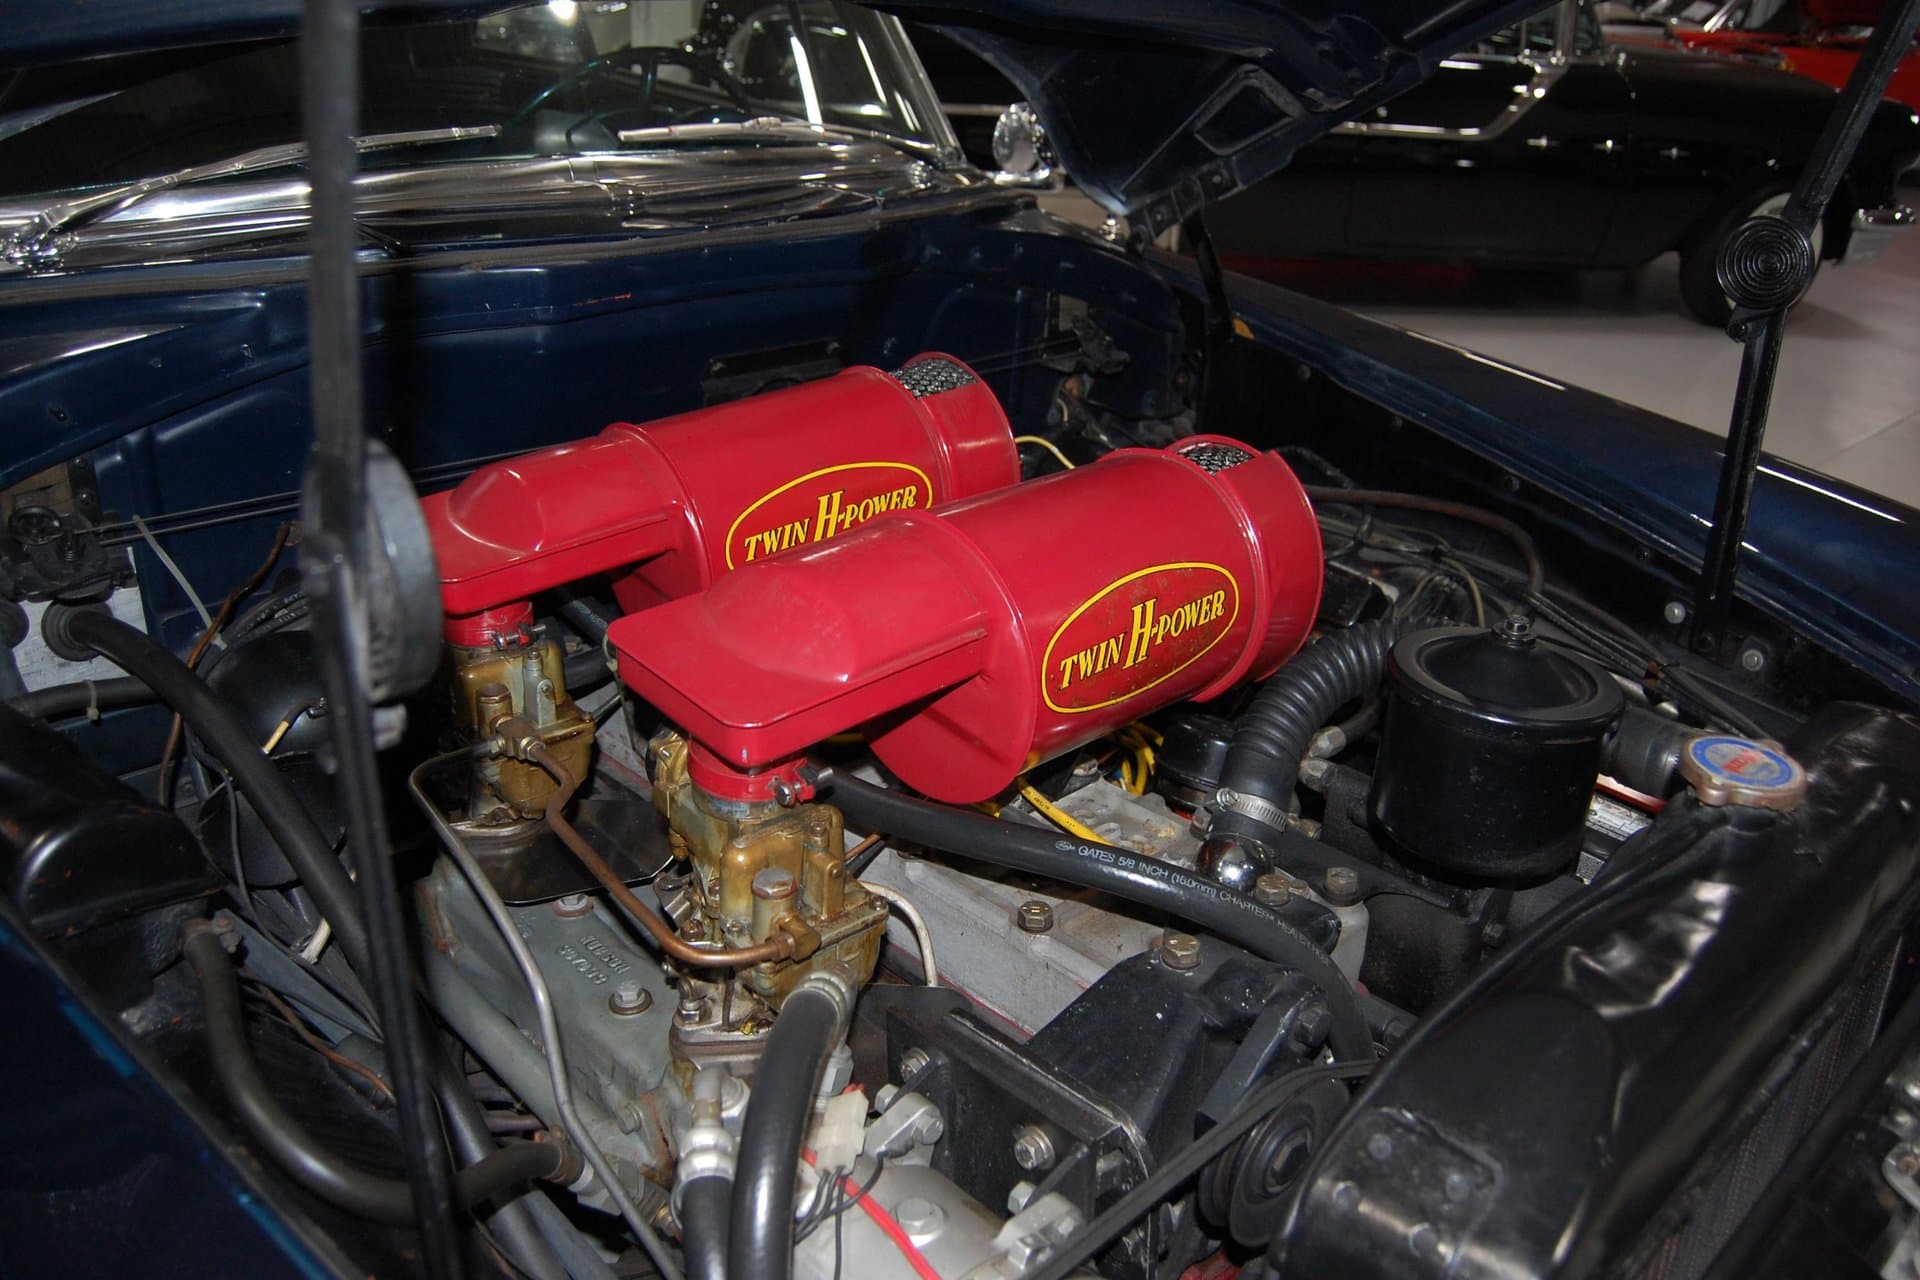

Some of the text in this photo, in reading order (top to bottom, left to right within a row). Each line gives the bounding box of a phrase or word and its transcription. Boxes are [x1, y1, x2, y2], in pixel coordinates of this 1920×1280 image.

[744, 486, 917, 562] TWIN H-POWER
[1059, 590, 1226, 690] TWIN H-POWER
[1078, 845, 1116, 863] GATES
[1117, 856, 1136, 868] 5/8
[1138, 861, 1169, 879] INCH
